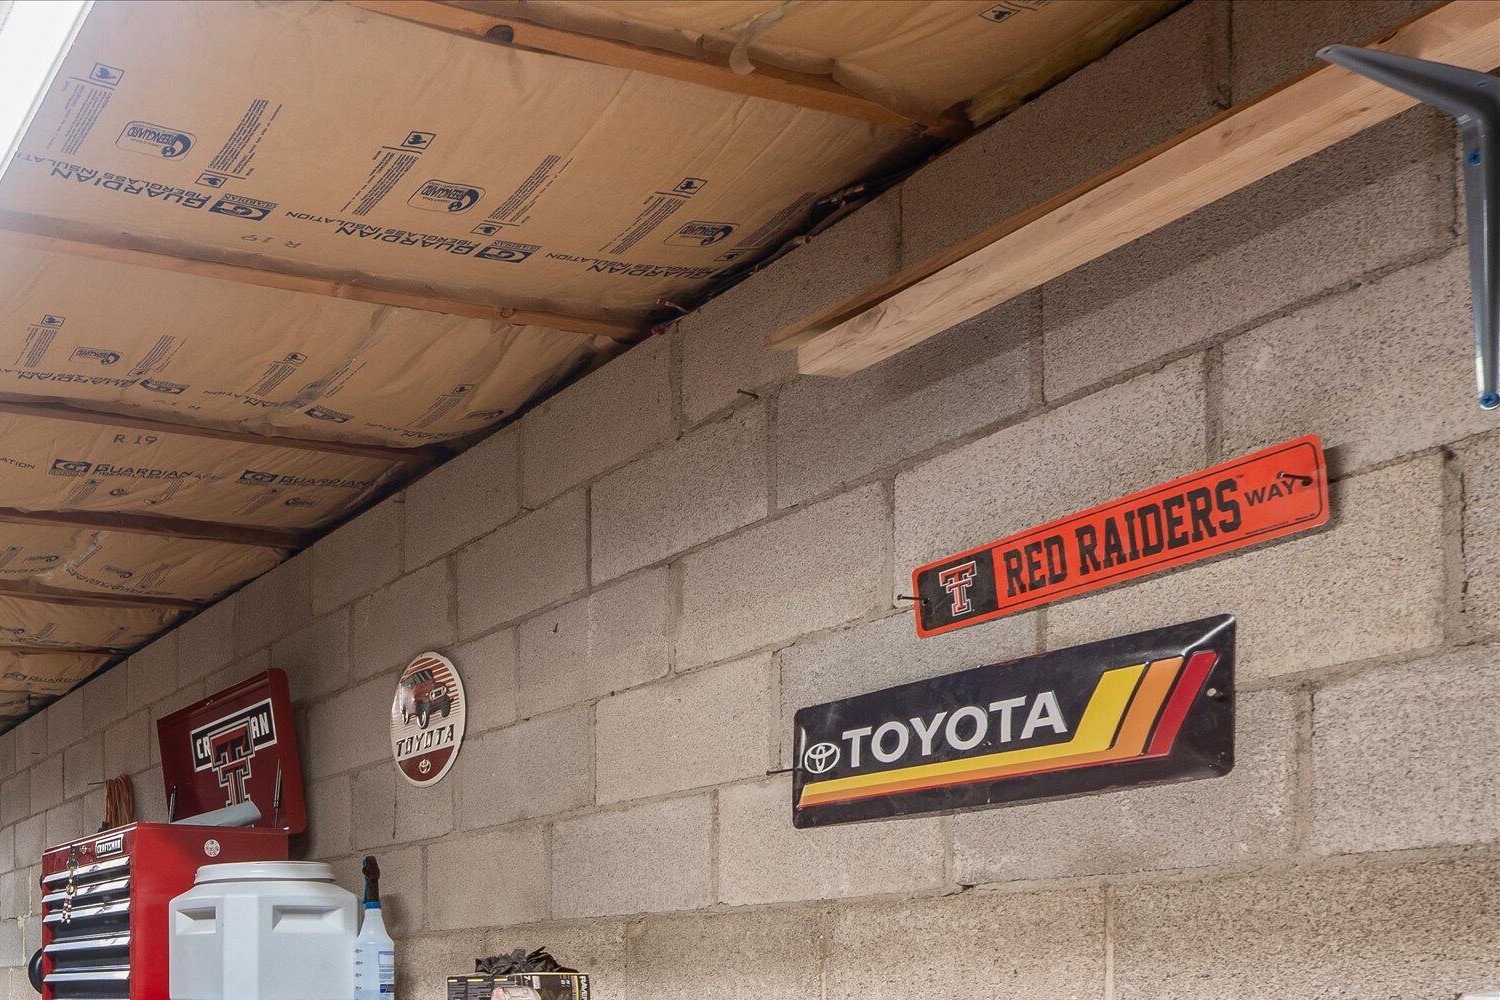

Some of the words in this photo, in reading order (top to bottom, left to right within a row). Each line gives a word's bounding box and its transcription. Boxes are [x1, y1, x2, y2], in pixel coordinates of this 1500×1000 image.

[50, 168, 208, 209] GUARDIAN
[103, 172, 213, 199] FIBERGLASS
[286, 211, 381, 233] INSULATION
[335, 226, 475, 254] GUARDIAN
[384, 229, 480, 249] FIBERGLASS
[1002, 537, 1068, 597] RED
[1076, 477, 1242, 576] RAIDERS
[1244, 478, 1296, 507] WAY
[396, 723, 455, 757] TOYOTA
[842, 691, 1068, 768] TOYOTA
[96, 838, 121, 855] CRAFTSMAN
